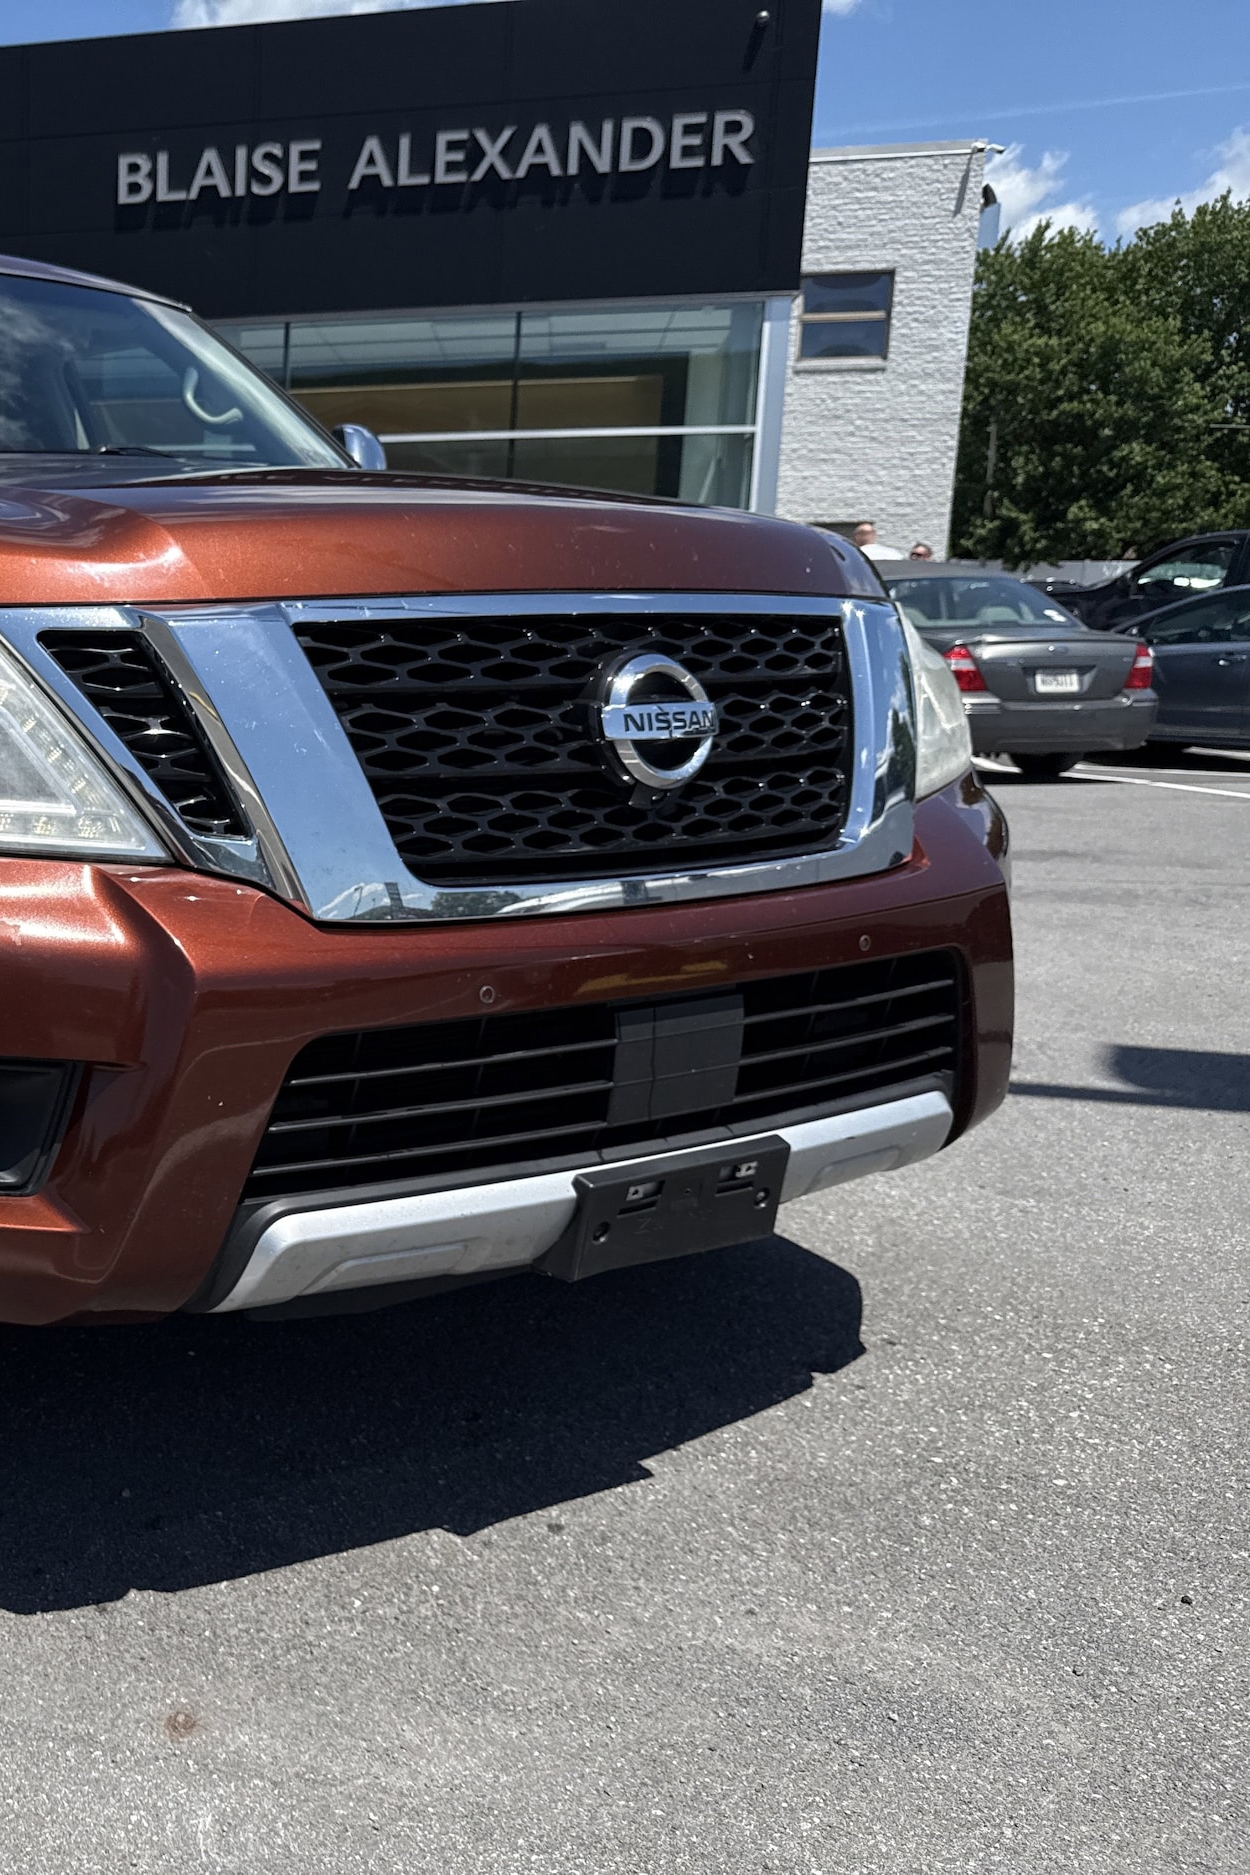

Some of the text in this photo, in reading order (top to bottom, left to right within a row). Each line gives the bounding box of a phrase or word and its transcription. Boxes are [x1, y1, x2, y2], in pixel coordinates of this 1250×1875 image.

[116, 108, 756, 206] BLAISE ALEXANDER
[623, 709, 716, 732] NISSAN
